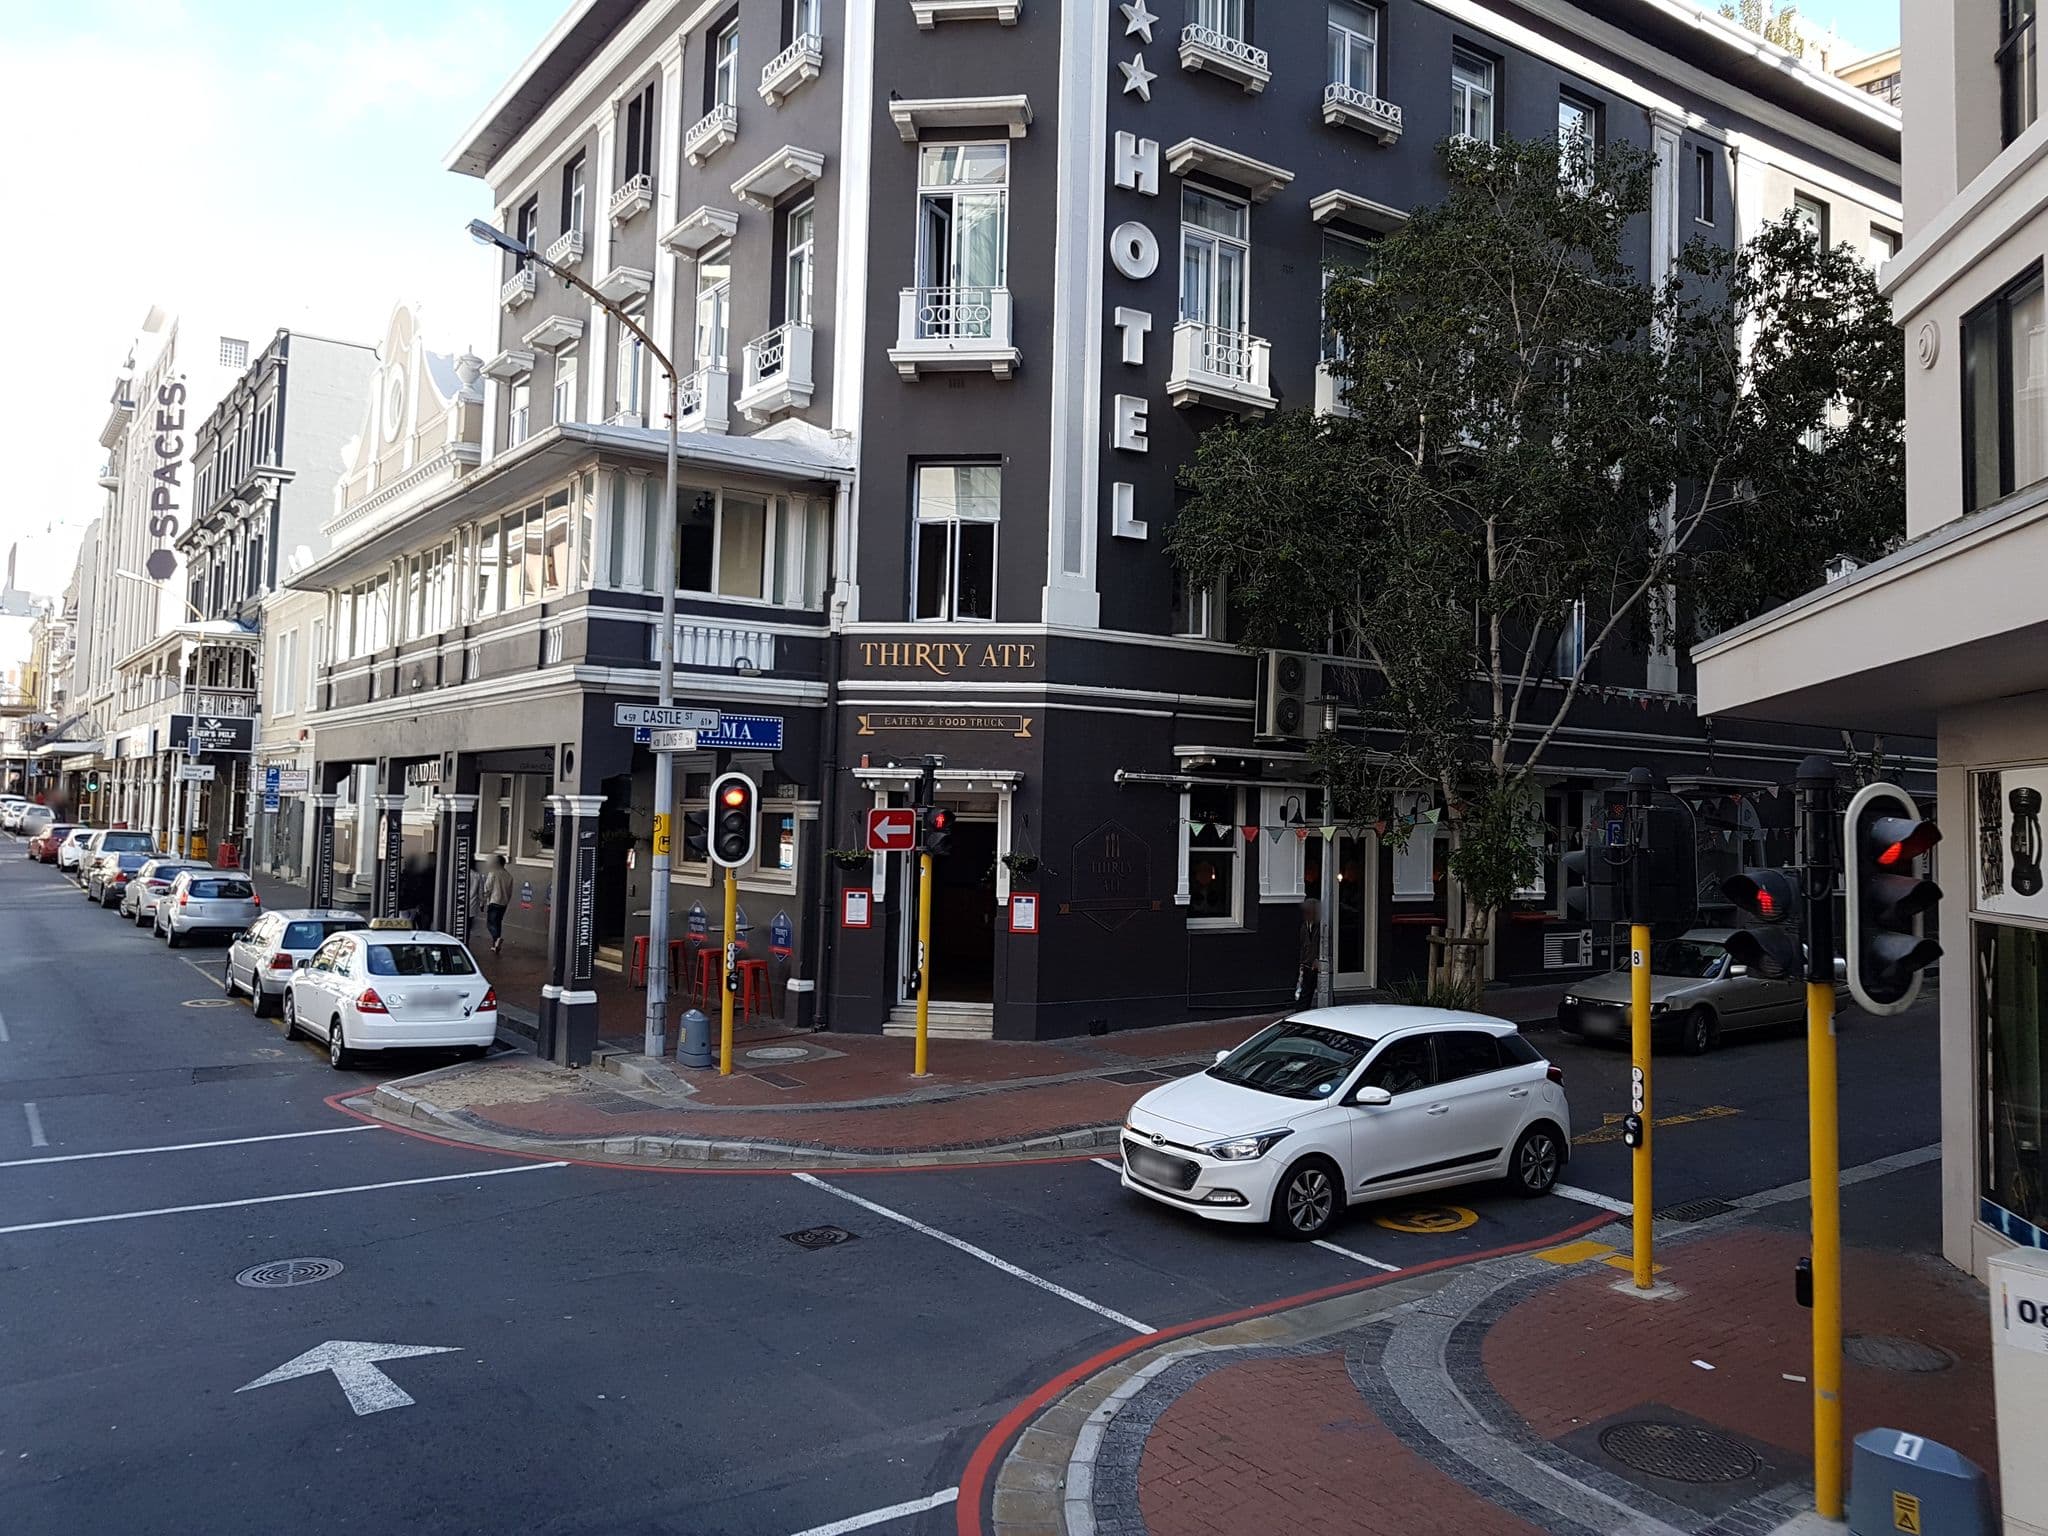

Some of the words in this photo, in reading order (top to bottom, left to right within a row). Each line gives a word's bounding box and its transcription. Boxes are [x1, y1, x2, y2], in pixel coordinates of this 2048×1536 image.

[1110, 130, 1160, 540] HOTEL
[860, 642, 971, 676] THIRTY
[979, 643, 1036, 668] ATE
[629, 713, 637, 721] 59
[643, 710, 682, 725] CASTLE
[685, 711, 693, 721] ST
[700, 717, 708, 726] 61
[884, 716, 924, 726] EATERY
[927, 717, 935, 726] &
[939, 718, 967, 727] FOOD
[971, 718, 1004, 727] TRUCK
[269, 768, 277, 777] P
[324, 833, 332, 862] CINEMA
[389, 834, 398, 883] COCKTAILS
[458, 839, 467, 880] EATERY
[322, 862, 330, 898] ROOFTOP
[458, 882, 466, 902] ATE
[581, 879, 592, 917] TRUCK
[378, 919, 408, 928] TAXI
[456, 903, 465, 941] THIRTY
[580, 917, 590, 946] FOOD
[1633, 951, 1640, 965] 8
